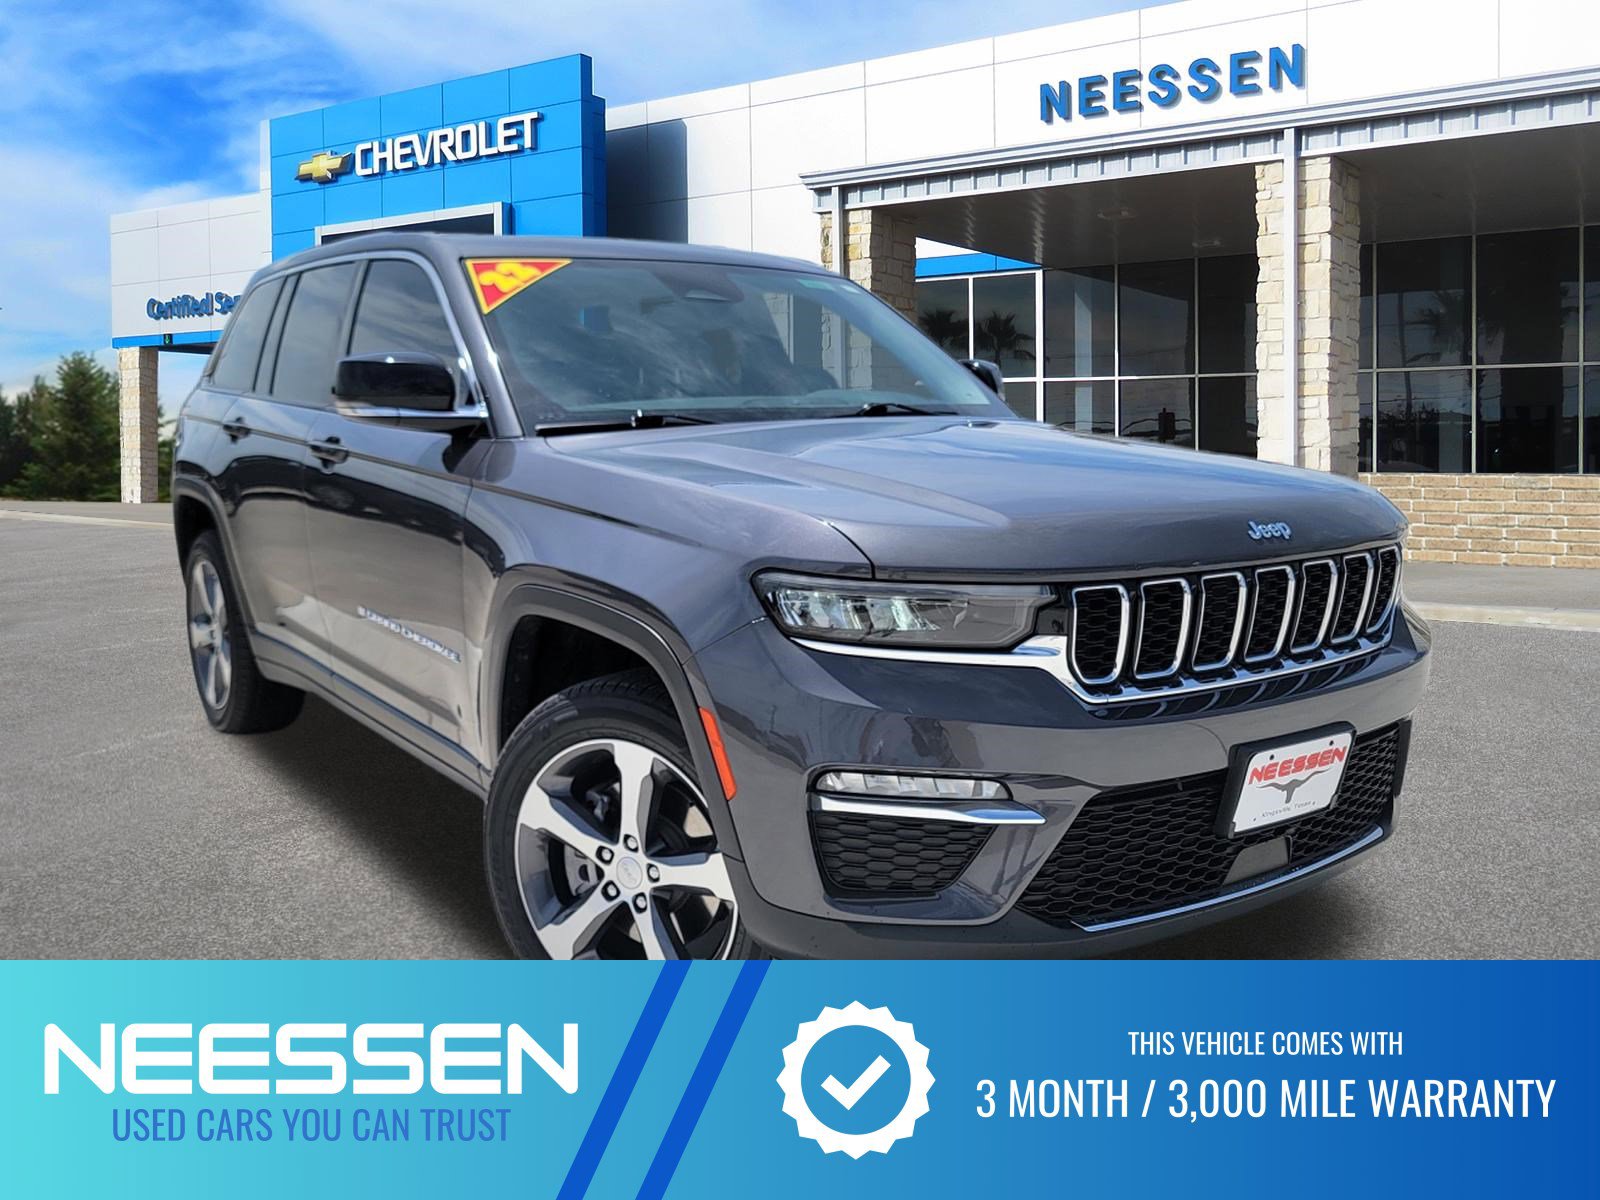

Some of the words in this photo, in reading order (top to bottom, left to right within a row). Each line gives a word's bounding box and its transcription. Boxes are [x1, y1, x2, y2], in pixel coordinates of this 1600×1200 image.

[1040, 43, 1306, 124] NEESSEN
[354, 111, 542, 177] CHEVROLET
[147, 292, 214, 320] Certified
[1247, 520, 1292, 540] Jeep
[1248, 746, 1348, 785] NEESSEN
